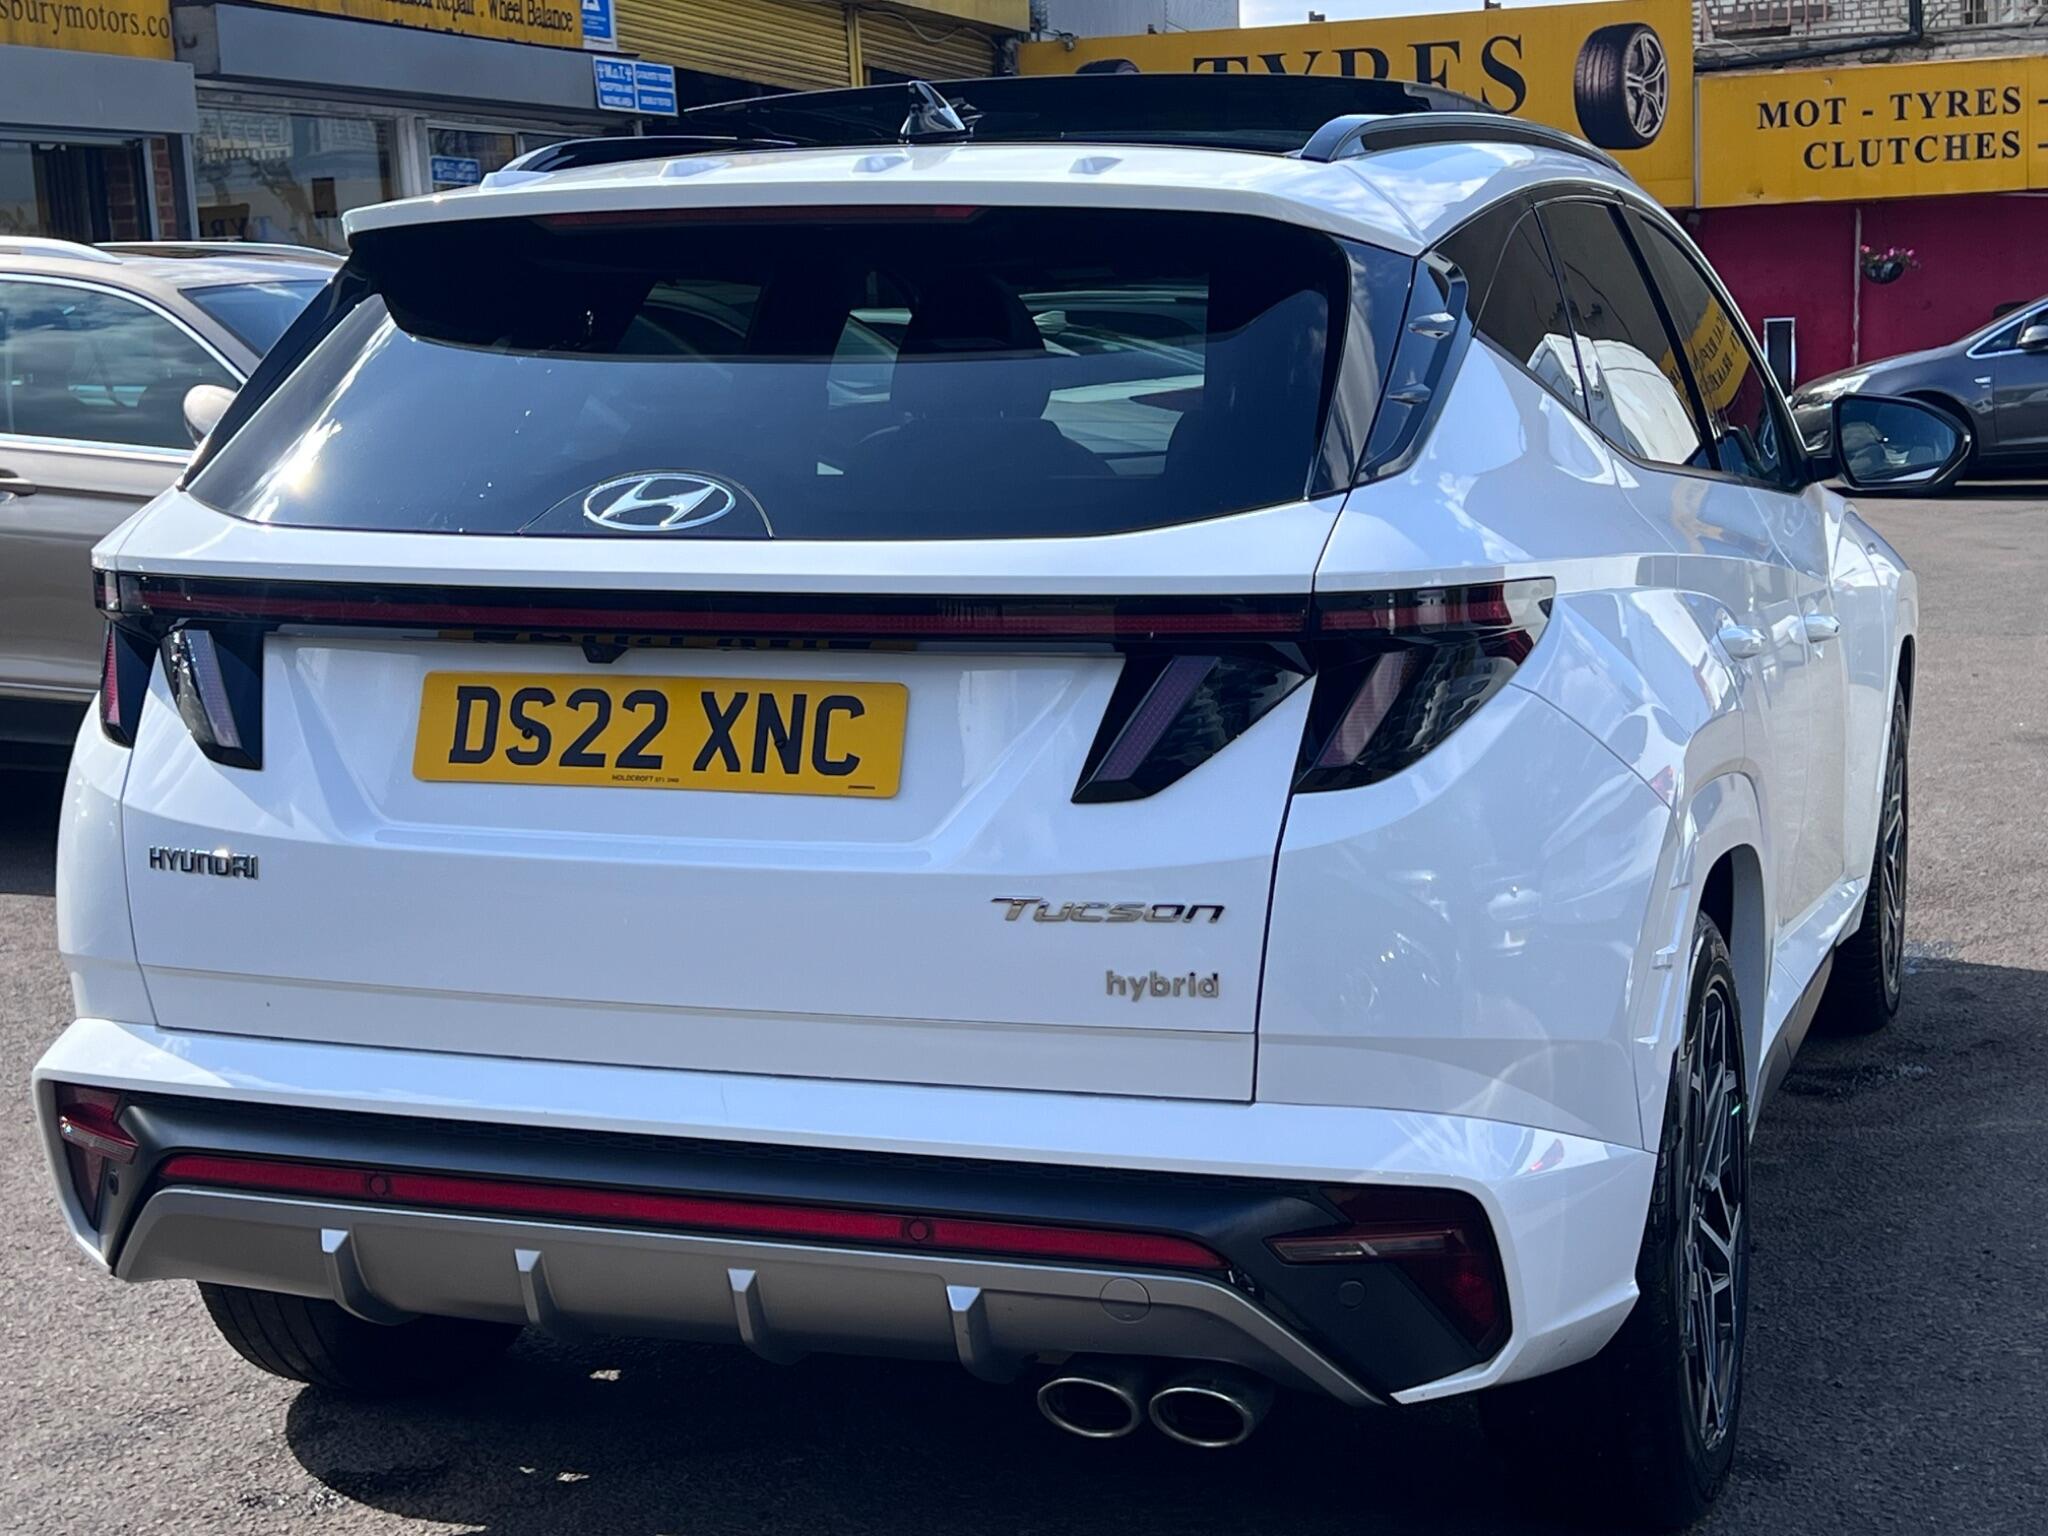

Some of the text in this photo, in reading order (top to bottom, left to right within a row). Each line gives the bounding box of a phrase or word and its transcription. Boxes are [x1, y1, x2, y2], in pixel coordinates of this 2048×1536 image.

[489, 0, 524, 25] Wheel
[527, 0, 573, 32] Balance
[1757, 97, 1847, 129] MOT
[1890, 86, 2021, 121] TYRES
[1804, 131, 2021, 170] CLUTCHES
[449, 685, 865, 776] DS22 XNC
[149, 845, 259, 880] HYUNDAI
[1104, 969, 1220, 1002] hybrid
